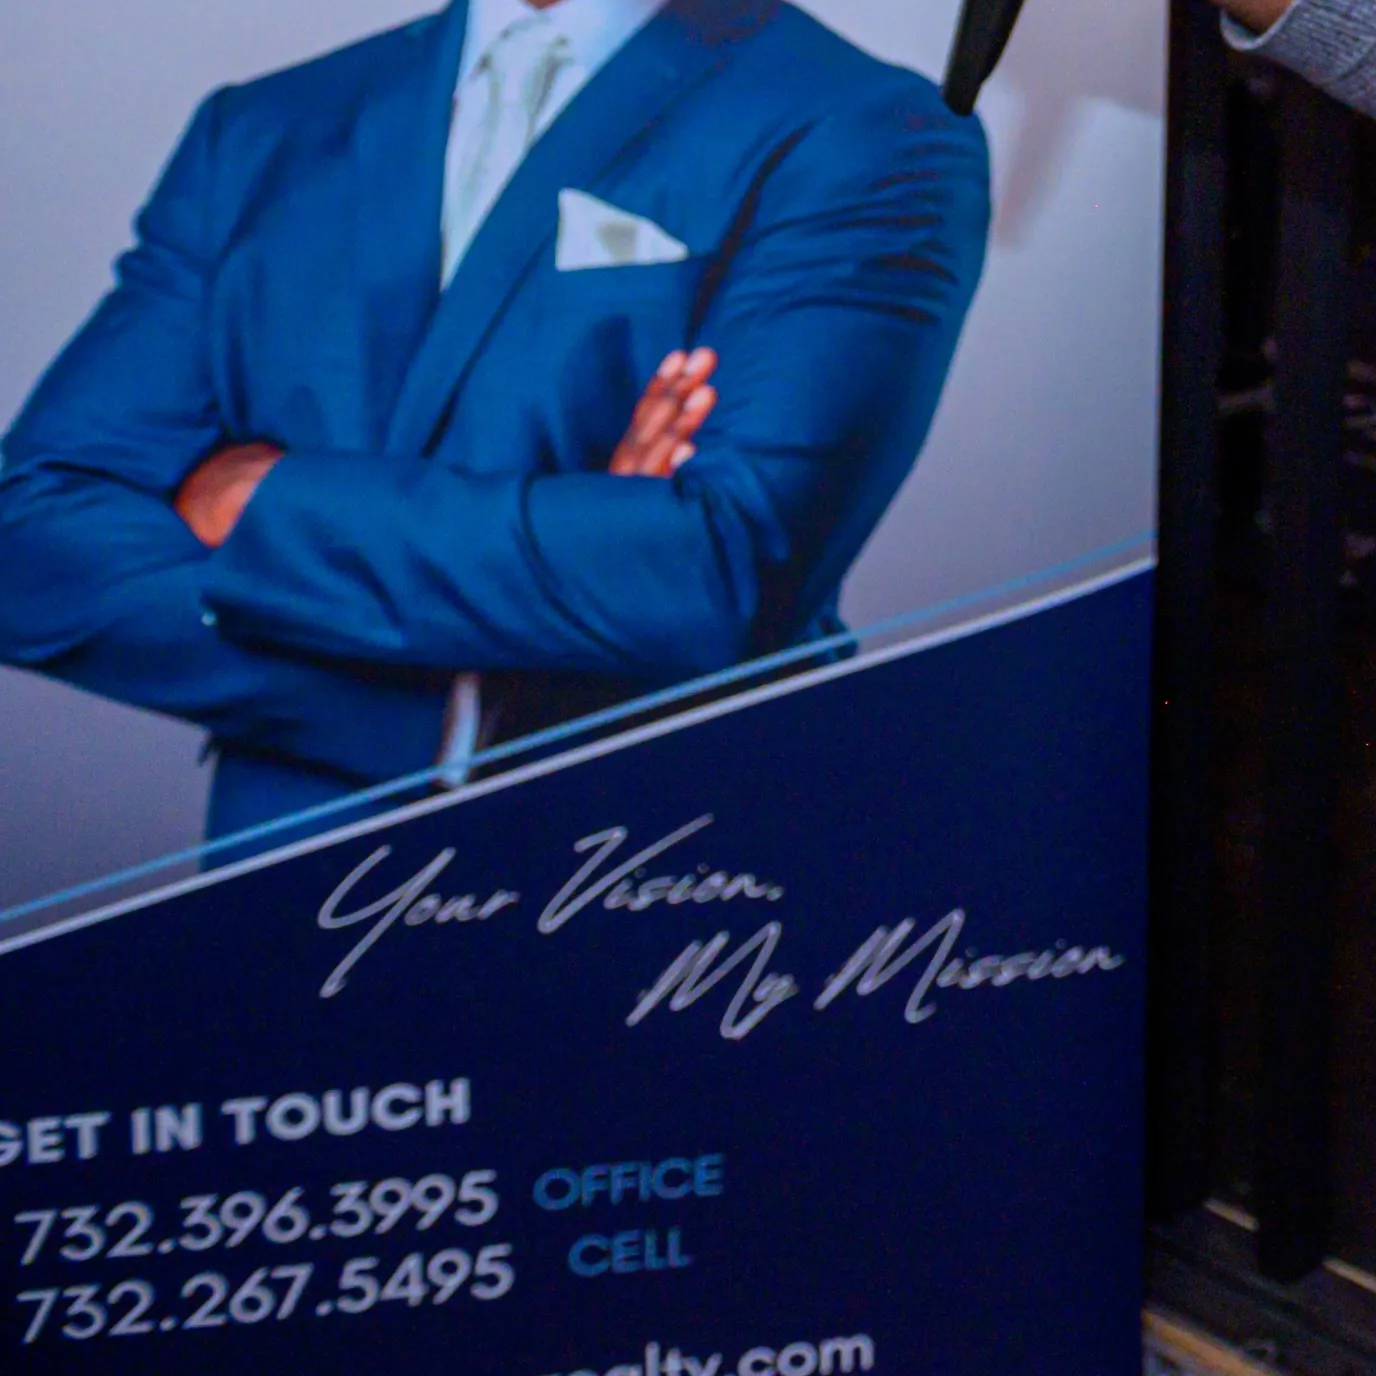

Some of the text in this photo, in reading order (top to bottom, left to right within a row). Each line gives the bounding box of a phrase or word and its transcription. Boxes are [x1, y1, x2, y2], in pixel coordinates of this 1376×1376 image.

[317, 845, 519, 998] Your
[625, 908, 1126, 1040] My Mission
[131, 1103, 203, 1155] IN
[221, 1077, 472, 1145] TOUCH
[14, 1152, 725, 1266] 732.396.3995 OFFICE
[16, 1226, 694, 1345] 732.267.5495 CELL
